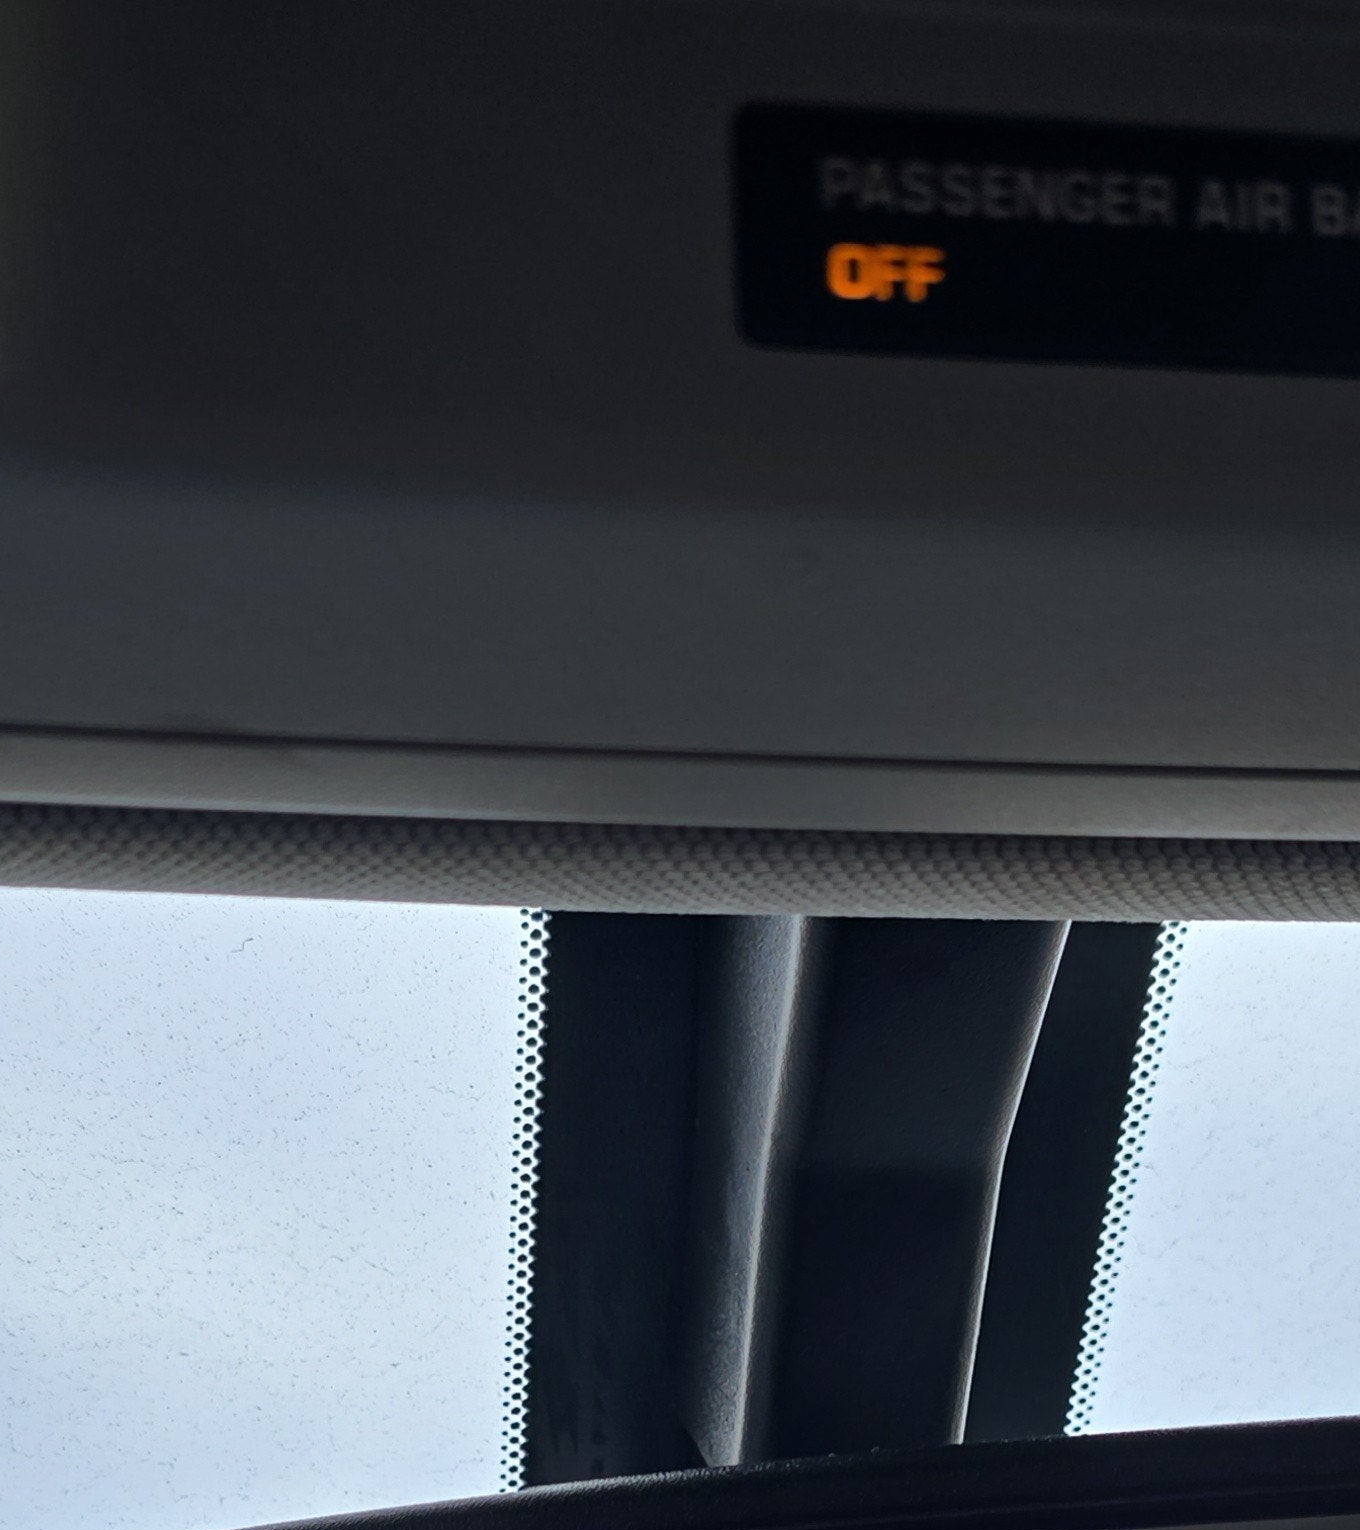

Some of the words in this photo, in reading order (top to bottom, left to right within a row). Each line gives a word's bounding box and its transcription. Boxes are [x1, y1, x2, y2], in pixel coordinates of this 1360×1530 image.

[823, 157, 1174, 226] PASSENGER
[1194, 177, 1292, 232] AIR
[826, 242, 946, 302] OFF
